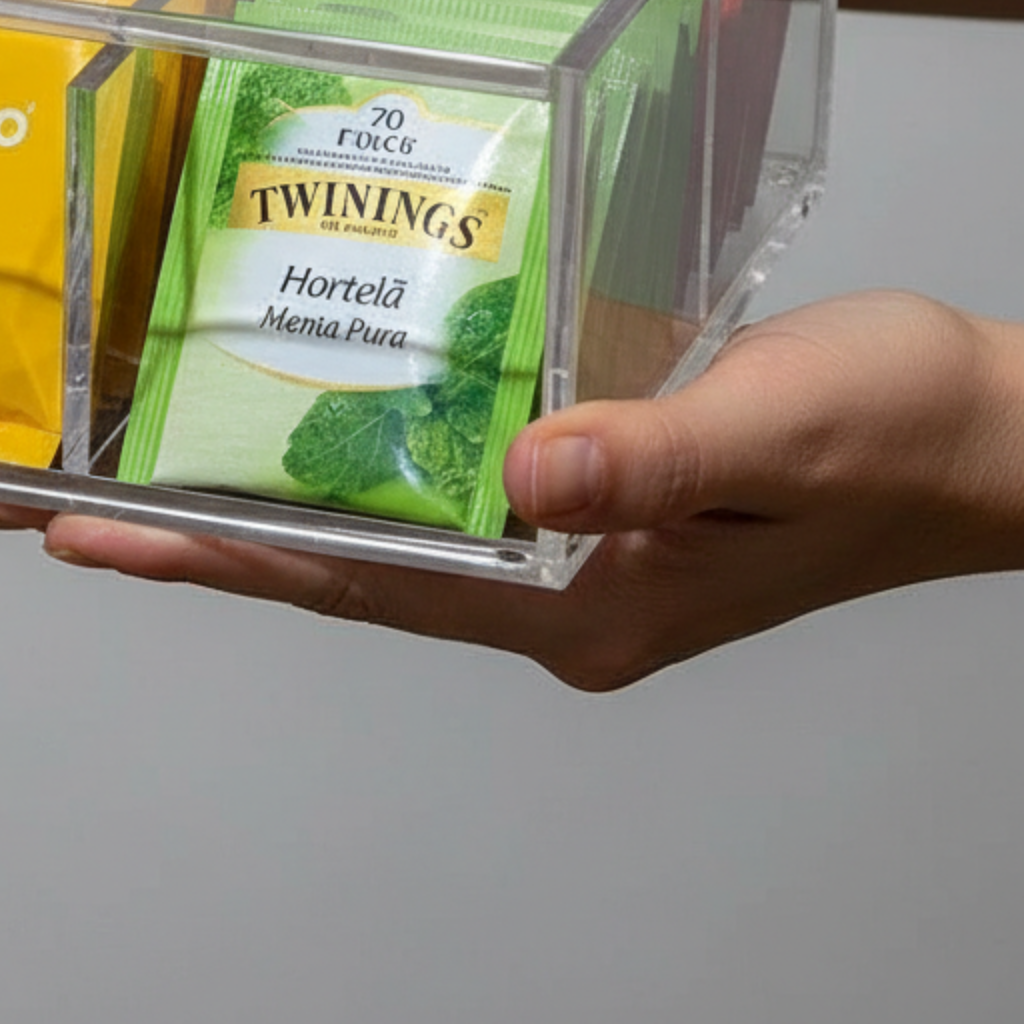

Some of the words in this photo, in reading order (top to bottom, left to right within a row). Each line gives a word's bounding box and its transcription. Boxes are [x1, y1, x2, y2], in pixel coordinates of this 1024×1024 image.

[370, 107, 406, 131] 70
[250, 181, 483, 250] TWININGS
[279, 265, 408, 309] Hortelã
[344, 317, 408, 349] Pura
